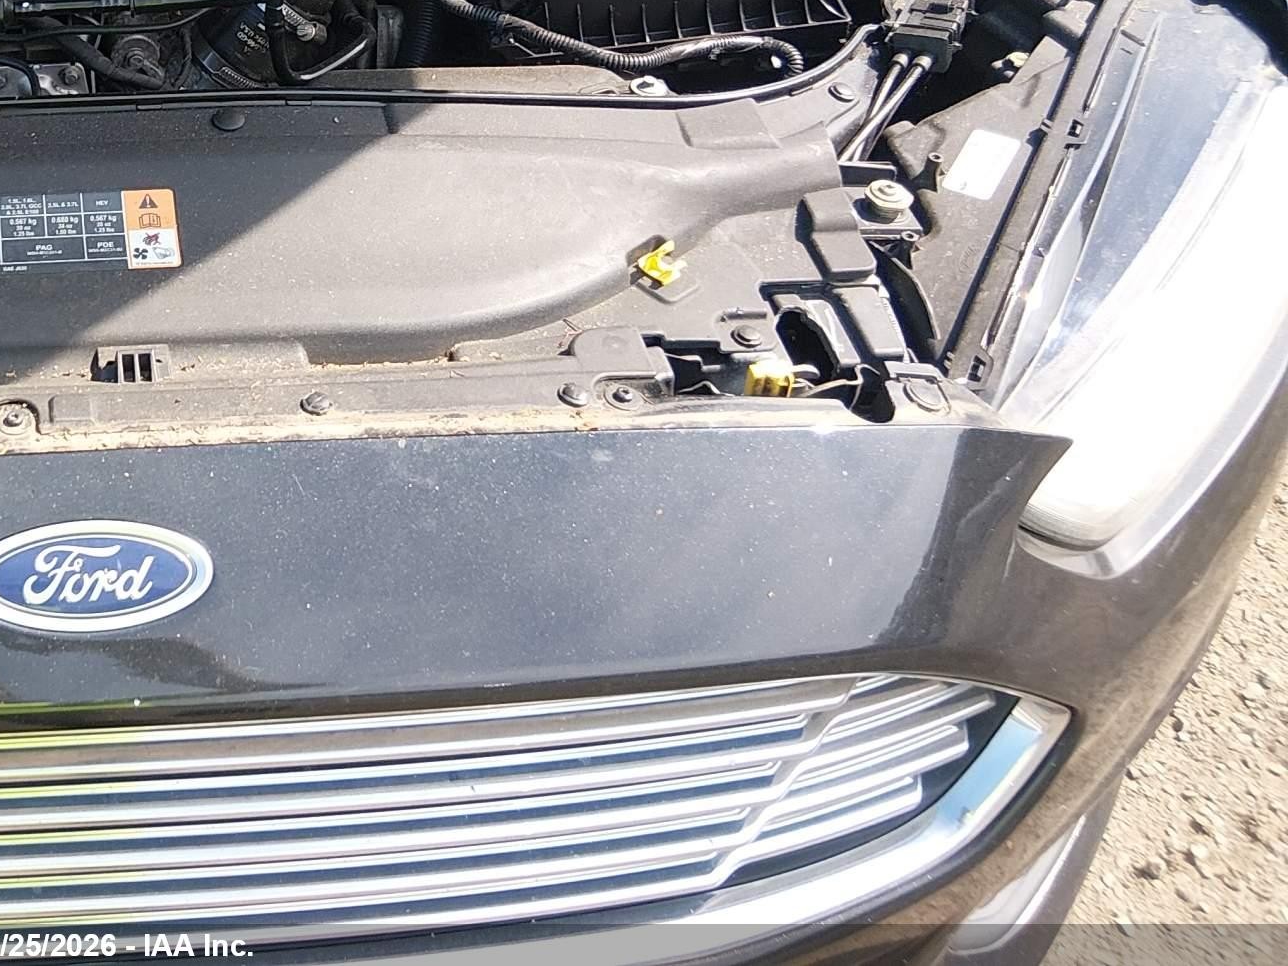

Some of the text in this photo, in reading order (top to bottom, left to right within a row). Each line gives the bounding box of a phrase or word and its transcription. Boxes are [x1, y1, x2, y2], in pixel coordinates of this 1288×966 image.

[27, 218, 37, 226] kg
[69, 216, 79, 224] kg
[107, 214, 117, 222] kg
[23, 544, 154, 605] Ford
